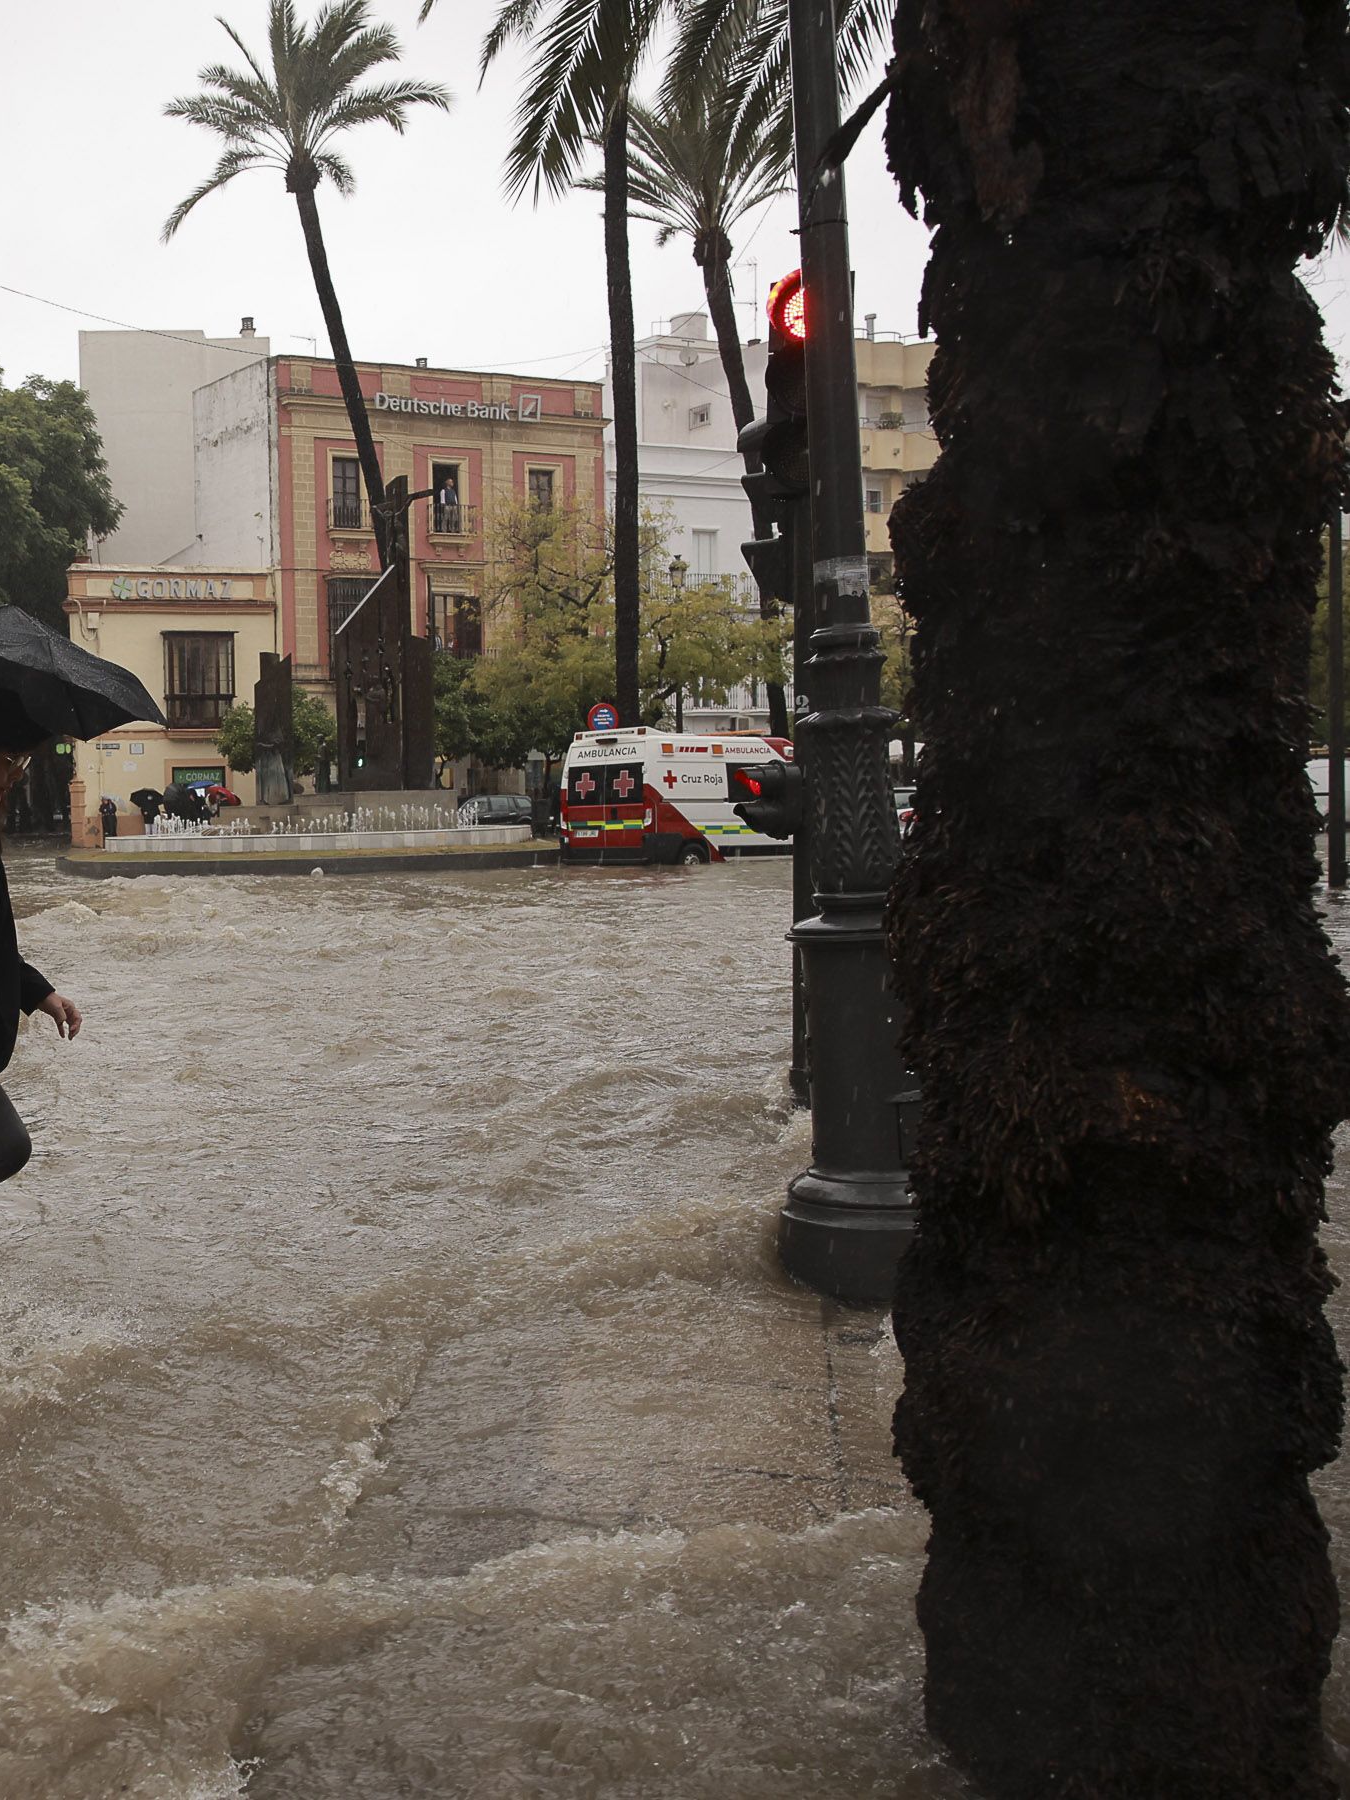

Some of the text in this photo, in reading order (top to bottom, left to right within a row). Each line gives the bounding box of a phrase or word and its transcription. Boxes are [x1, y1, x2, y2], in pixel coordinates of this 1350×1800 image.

[374, 391, 511, 421] Deutsche Bank
[136, 578, 232, 600] GORMAZ
[577, 746, 637, 759] AMBULANCIA
[724, 747, 771, 755] AMBULANCIA
[185, 772, 220, 782] GORMAZ
[681, 774, 723, 786] Cruz Roja
